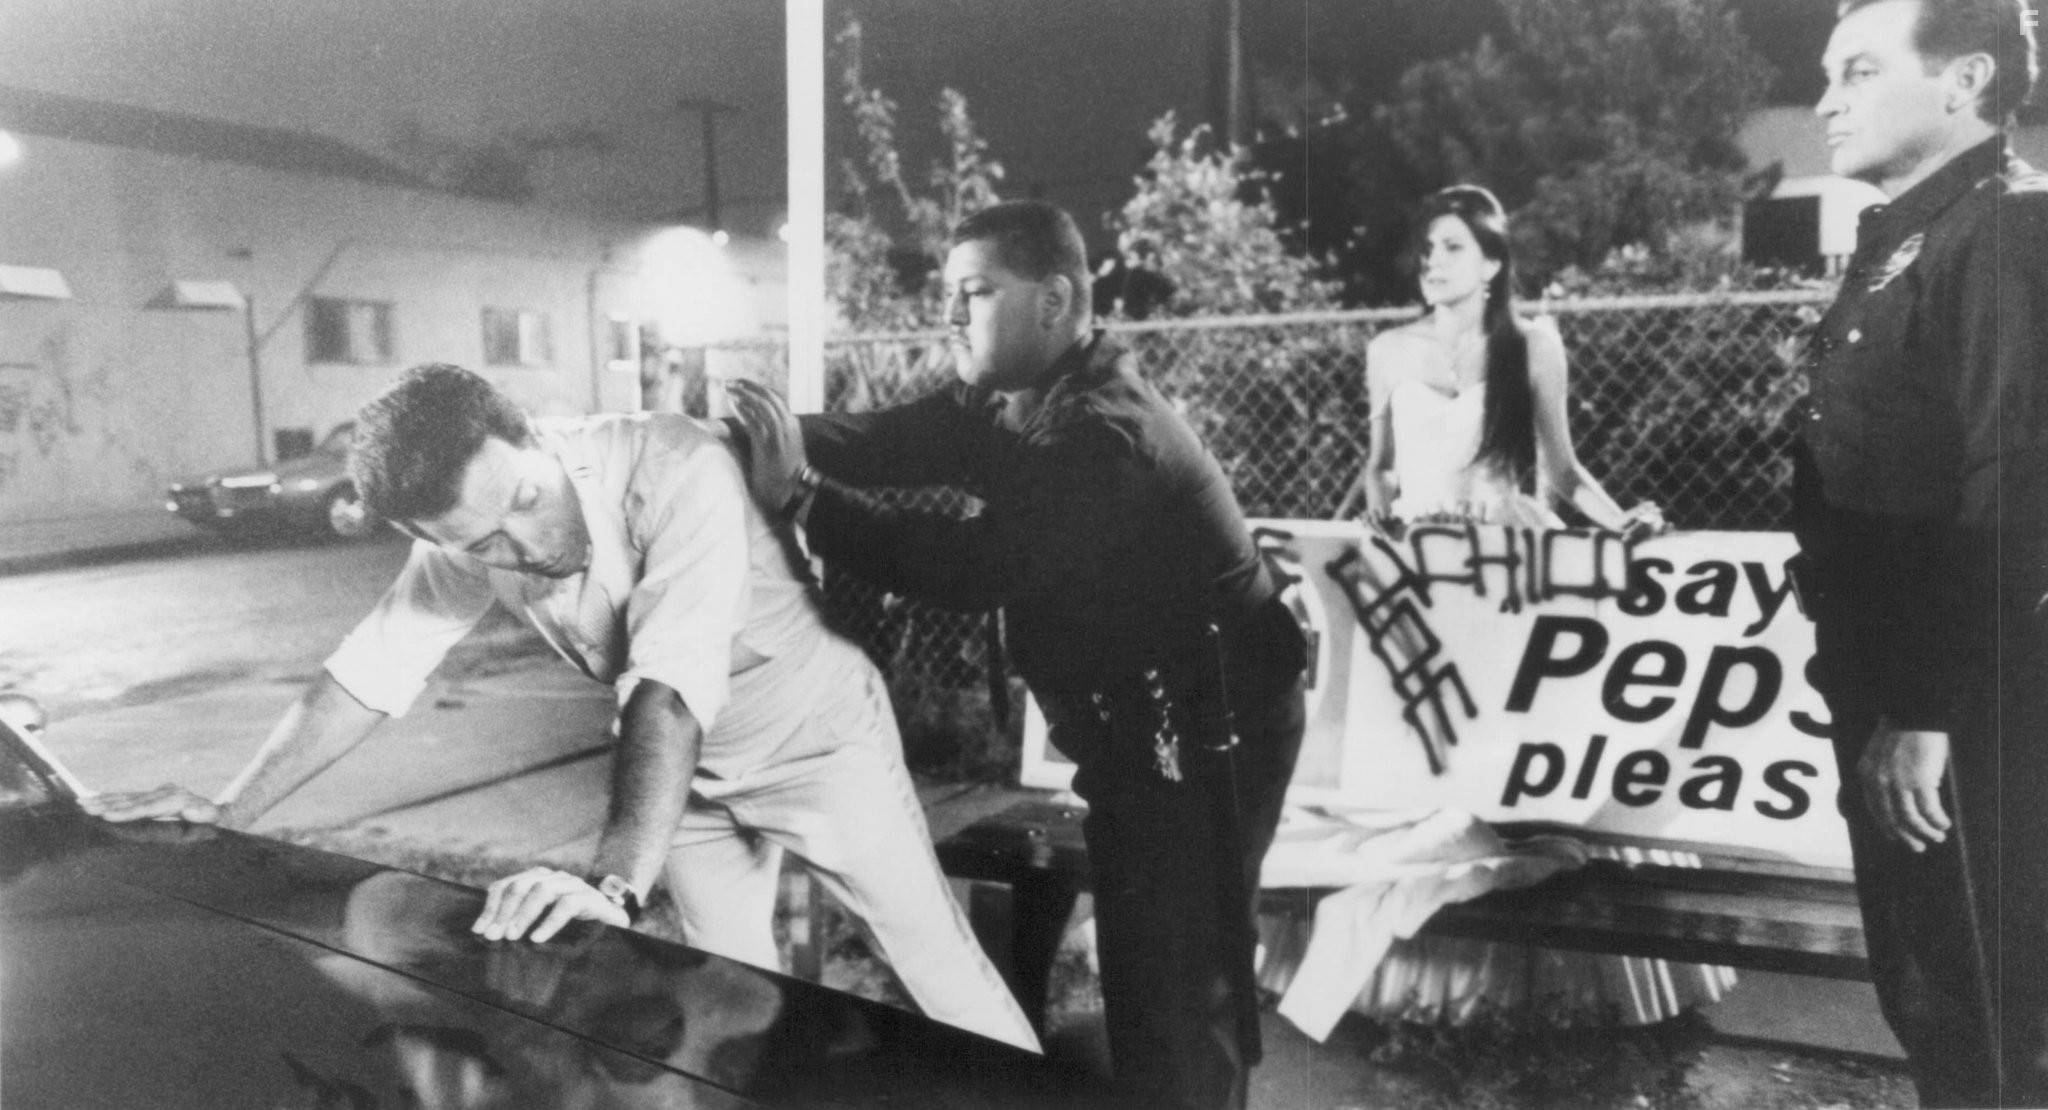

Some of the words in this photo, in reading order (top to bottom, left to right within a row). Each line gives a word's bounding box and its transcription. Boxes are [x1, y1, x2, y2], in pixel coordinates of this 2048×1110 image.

[1410, 525, 1633, 615] CHICO
[1616, 557, 1801, 637] say
[1500, 735, 1818, 820] pleas
